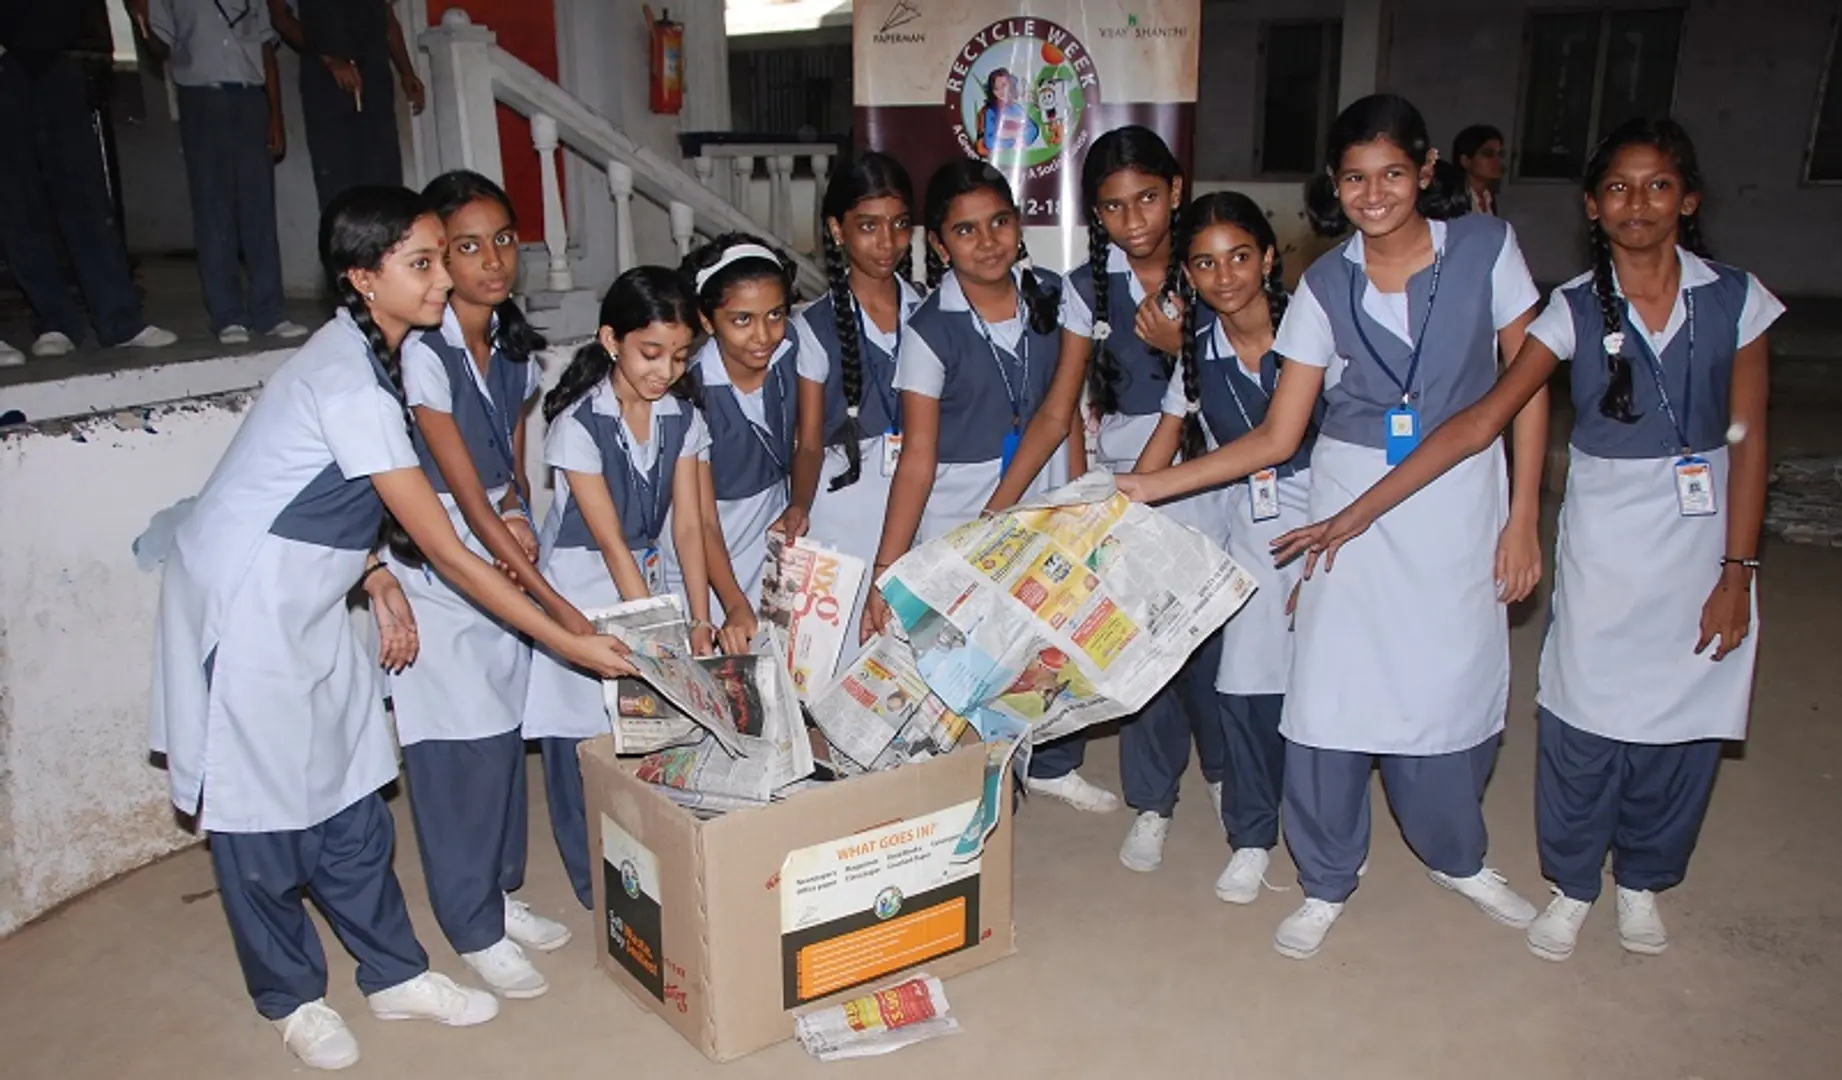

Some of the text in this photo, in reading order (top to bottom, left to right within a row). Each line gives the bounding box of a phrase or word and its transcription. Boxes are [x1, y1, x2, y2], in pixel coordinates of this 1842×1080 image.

[872, 33, 925, 44] PAPERMAN
[946, 20, 1097, 92] RECYCLE WEEK
[836, 840, 876, 861] WHAT
[879, 829, 914, 849] GOES
